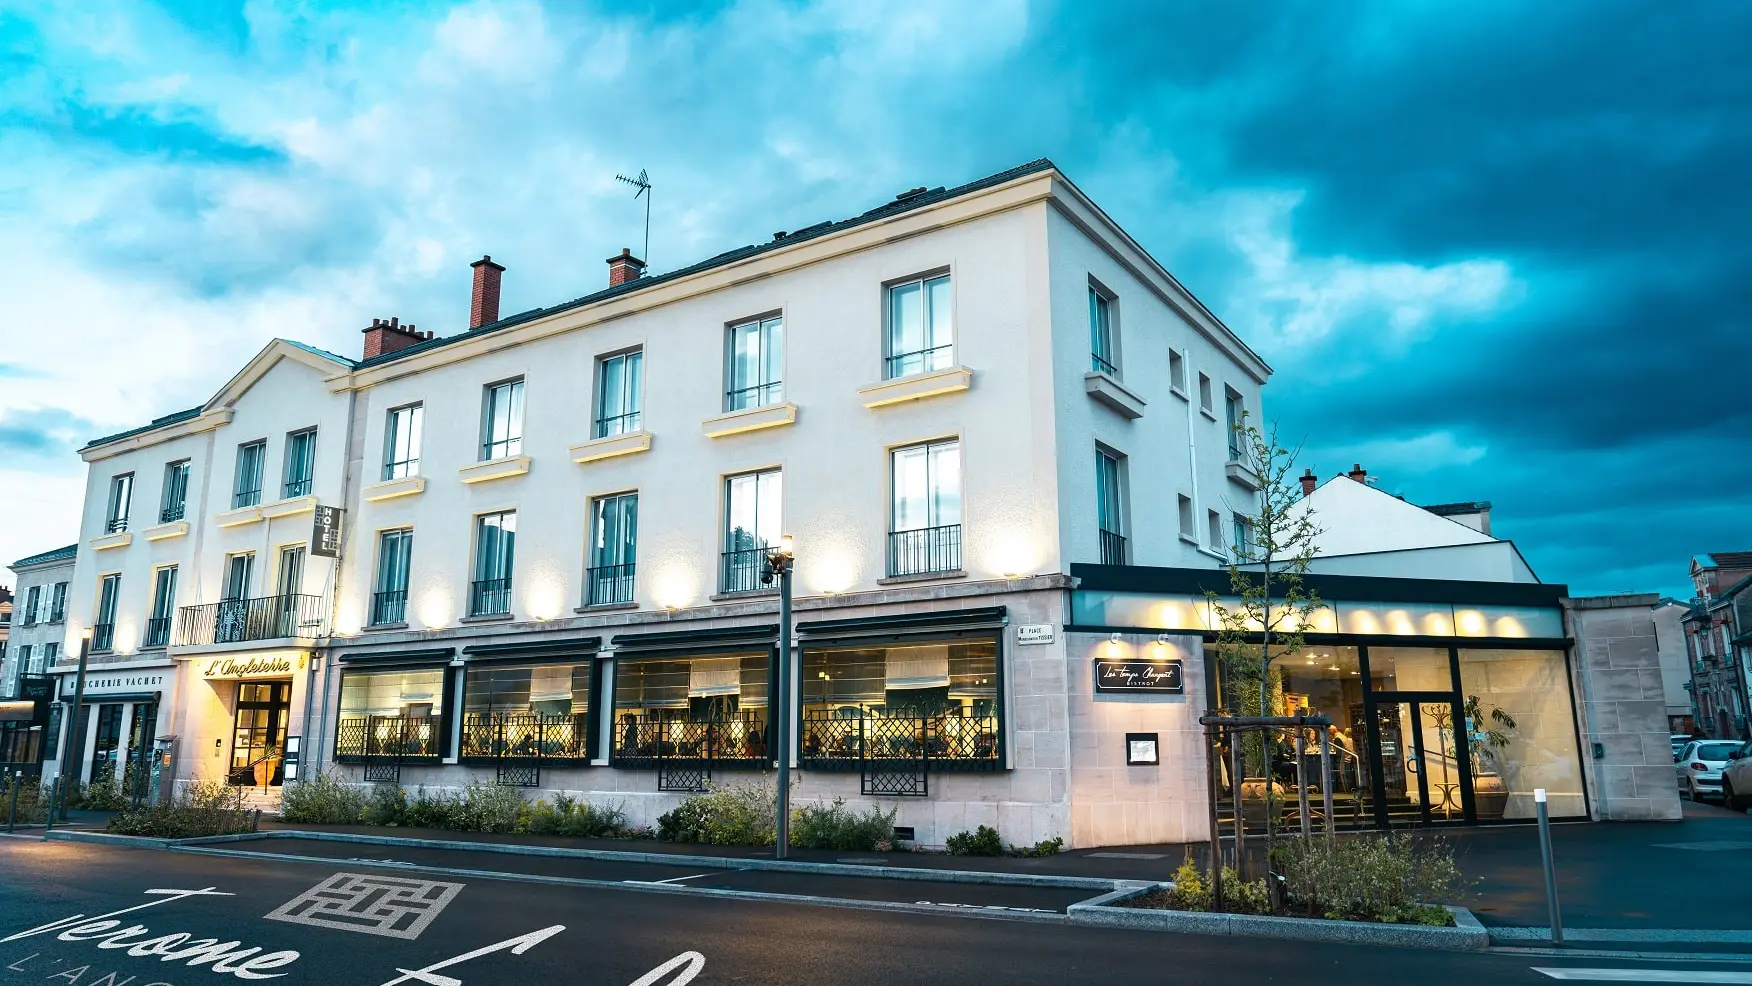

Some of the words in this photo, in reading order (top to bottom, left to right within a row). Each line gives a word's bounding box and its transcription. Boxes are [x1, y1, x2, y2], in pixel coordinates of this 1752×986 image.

[322, 507, 332, 550] HOTEL
[1104, 666, 1116, 678] Les
[126, 676, 163, 686] VACHET
